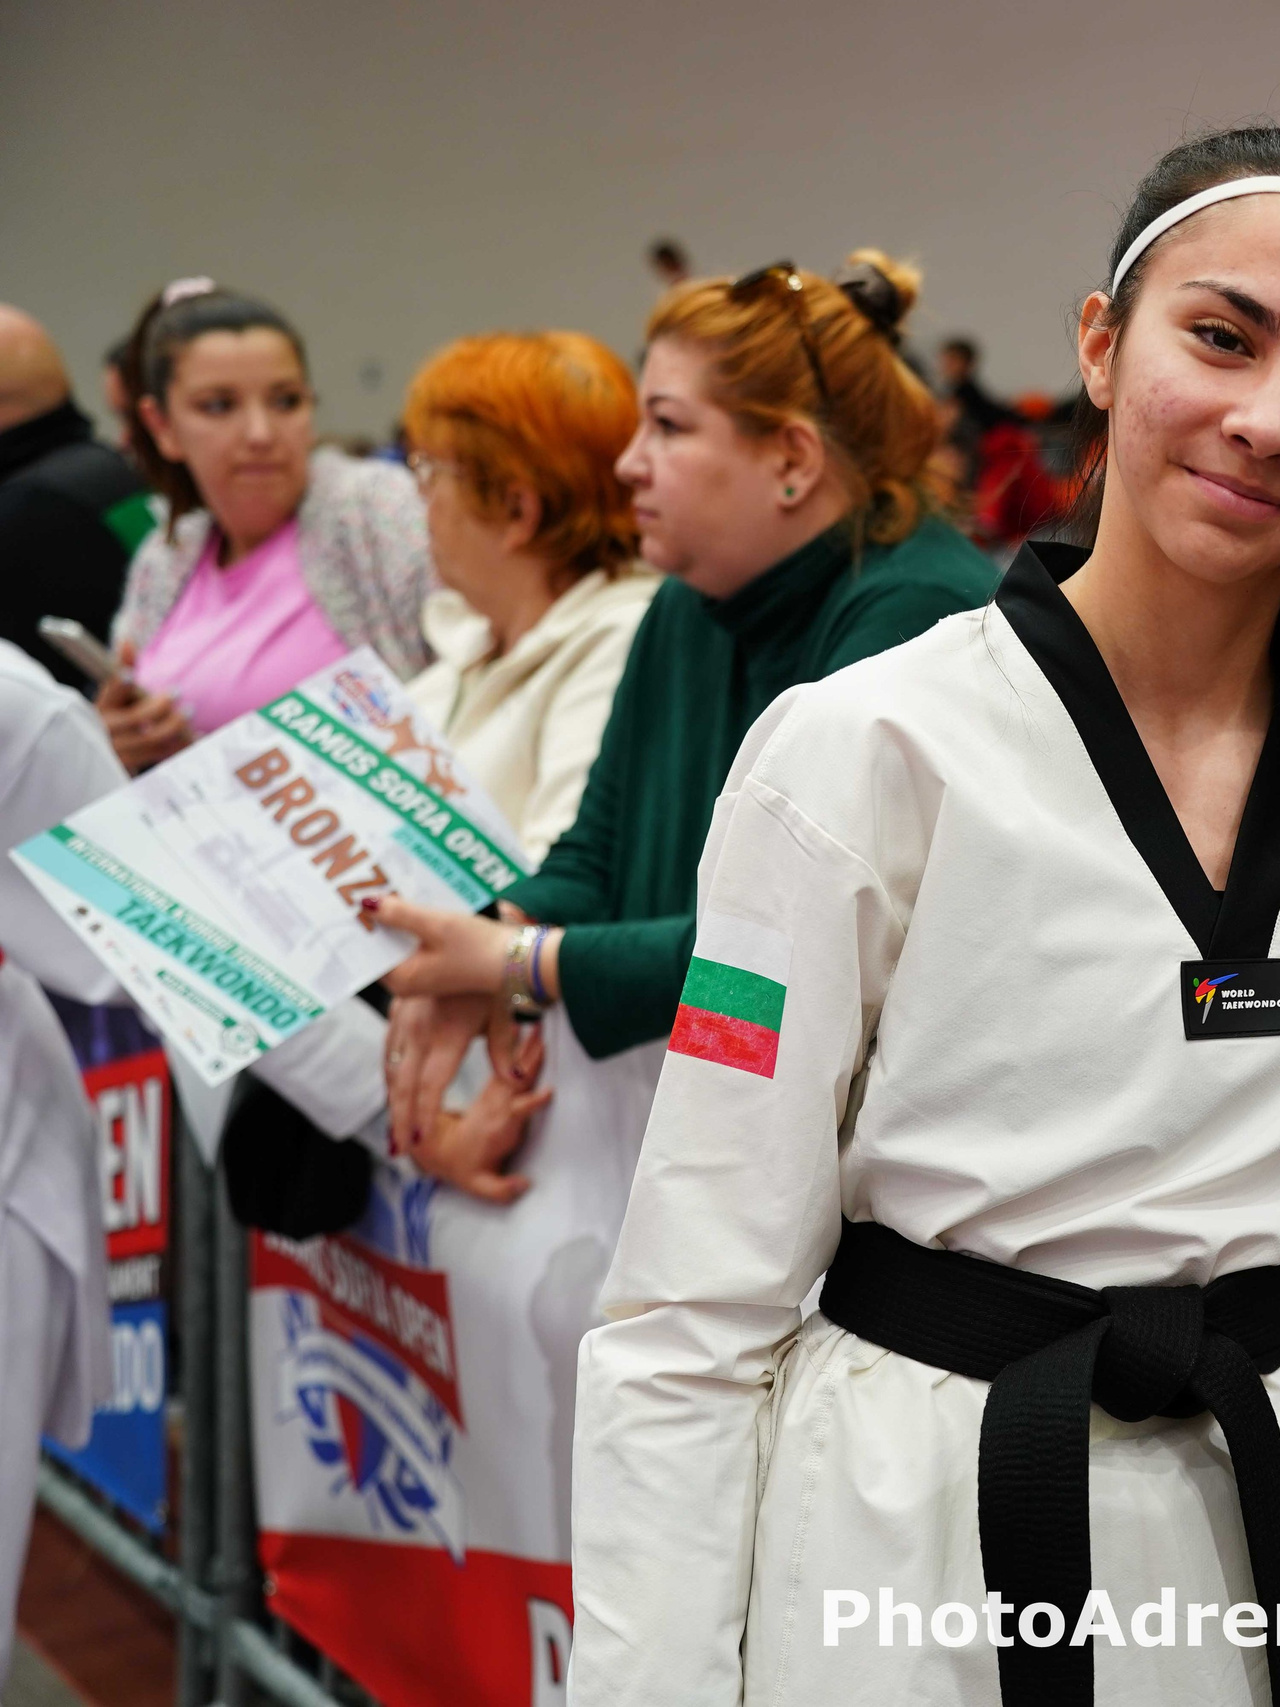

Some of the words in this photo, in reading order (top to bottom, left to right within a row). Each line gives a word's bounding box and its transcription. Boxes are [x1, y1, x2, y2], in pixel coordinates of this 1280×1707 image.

[269, 697, 379, 777] RAMUS
[367, 768, 452, 837] SOFIA
[444, 827, 518, 892] OPEN
[116, 899, 298, 1030] TAEKWONDO
[1221, 988, 1255, 998] WORLD
[100, 1077, 162, 1230] EN
